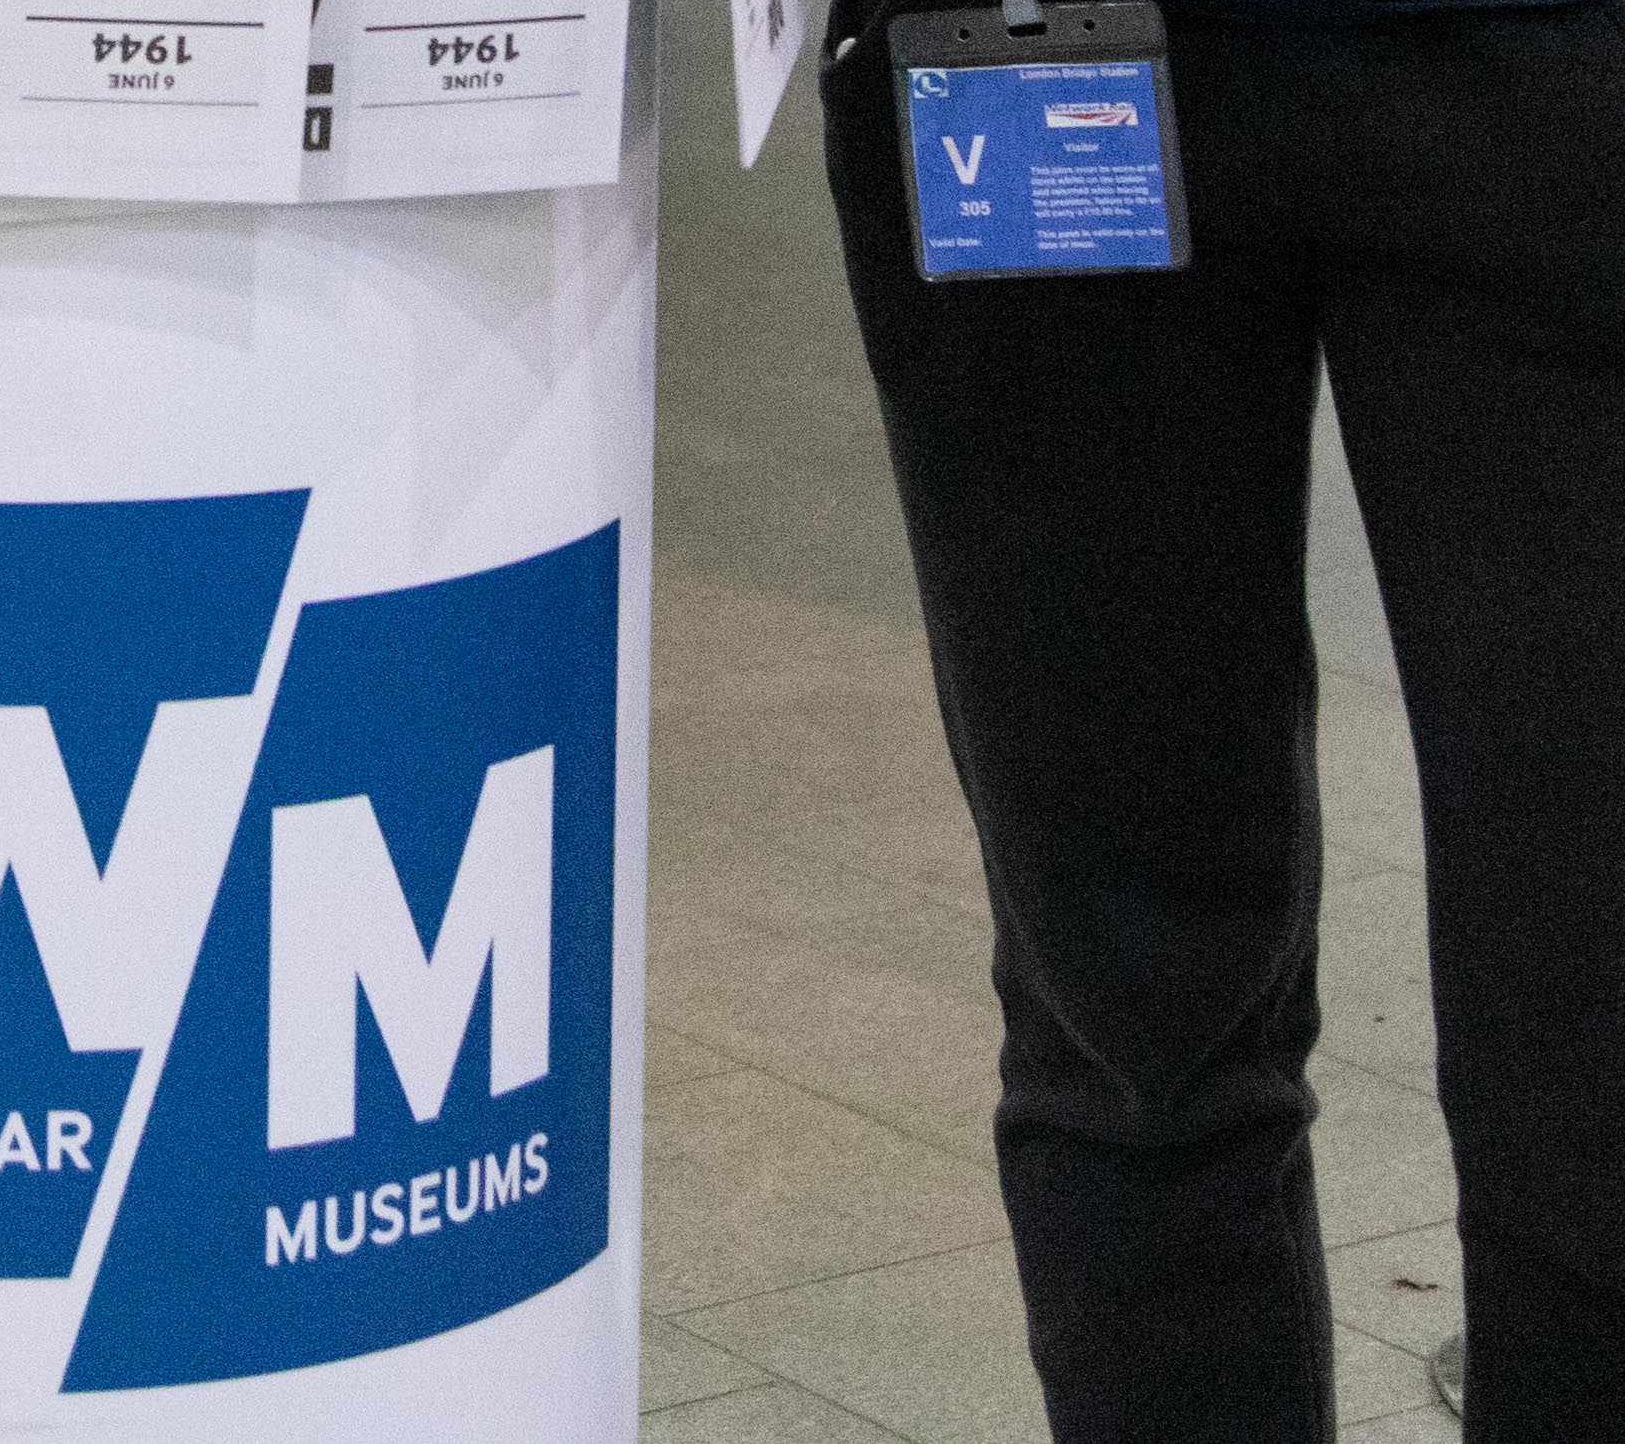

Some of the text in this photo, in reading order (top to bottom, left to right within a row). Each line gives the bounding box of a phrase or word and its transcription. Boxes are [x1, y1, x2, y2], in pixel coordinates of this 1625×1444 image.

[91, 32, 193, 65] 1944
[427, 32, 520, 65] 1944
[108, 73, 175, 93] 6 JUNE
[442, 72, 505, 93] 6 JUNE
[941, 134, 986, 186] V
[958, 200, 992, 217] 305
[265, 1132, 550, 1267] MUSEUMS
